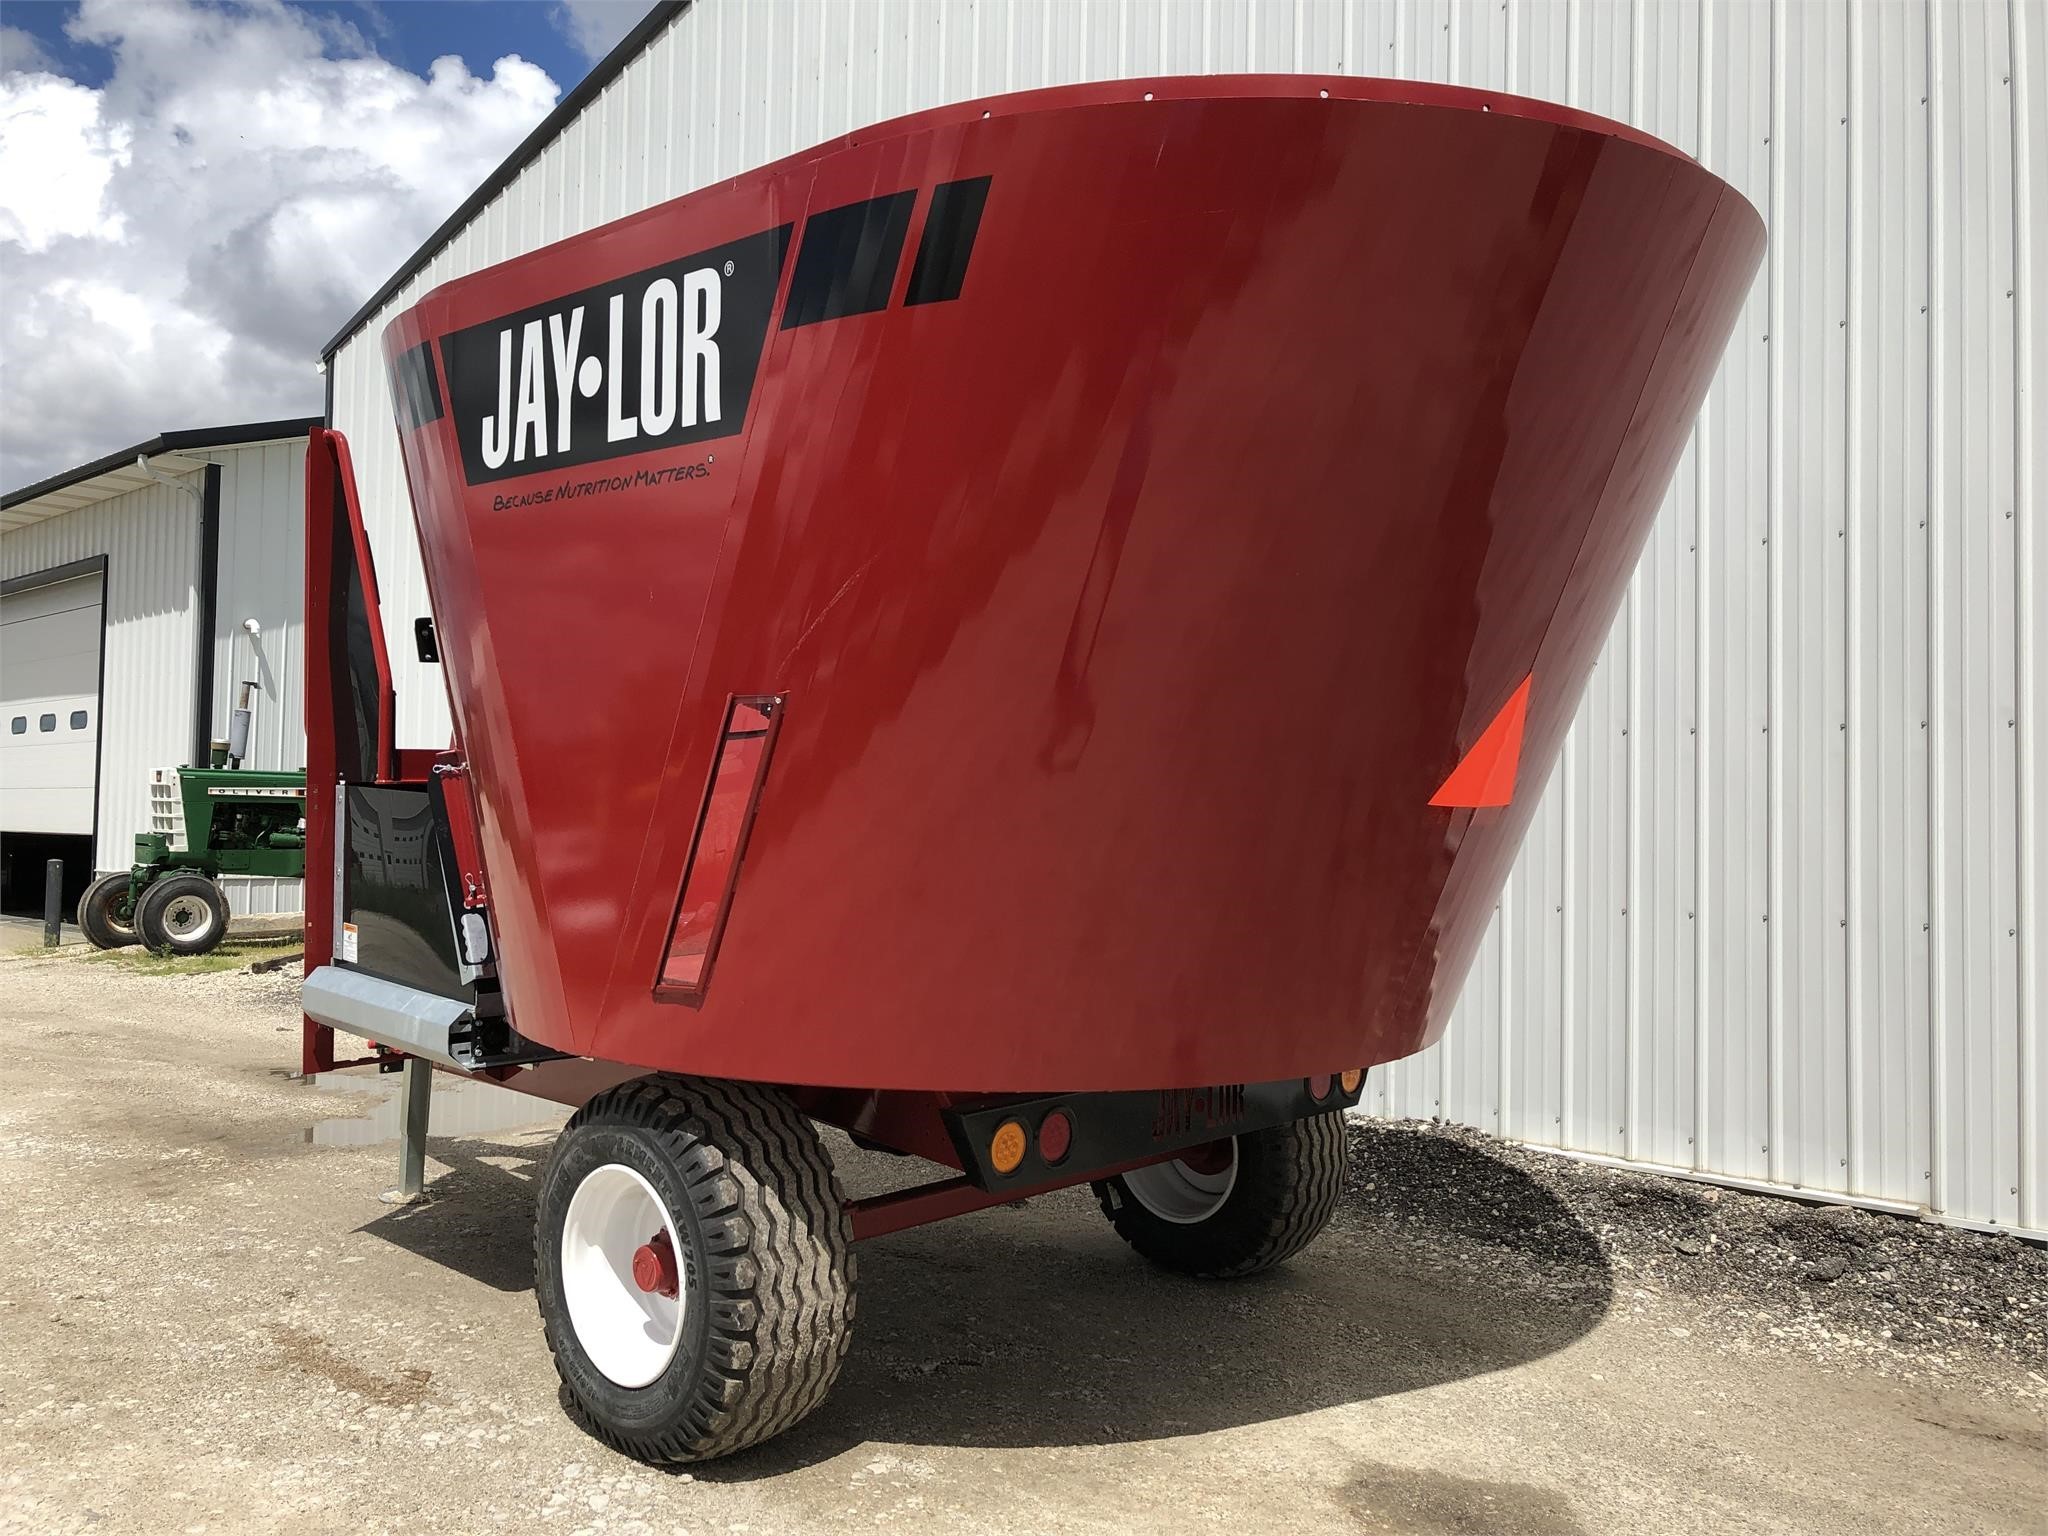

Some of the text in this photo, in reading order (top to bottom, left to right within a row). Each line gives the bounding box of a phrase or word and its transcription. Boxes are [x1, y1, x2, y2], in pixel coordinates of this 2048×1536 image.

[493, 488, 553, 512] BECAUSE
[555, 475, 633, 501] NUTRITION
[218, 788, 289, 796] OLIVER
